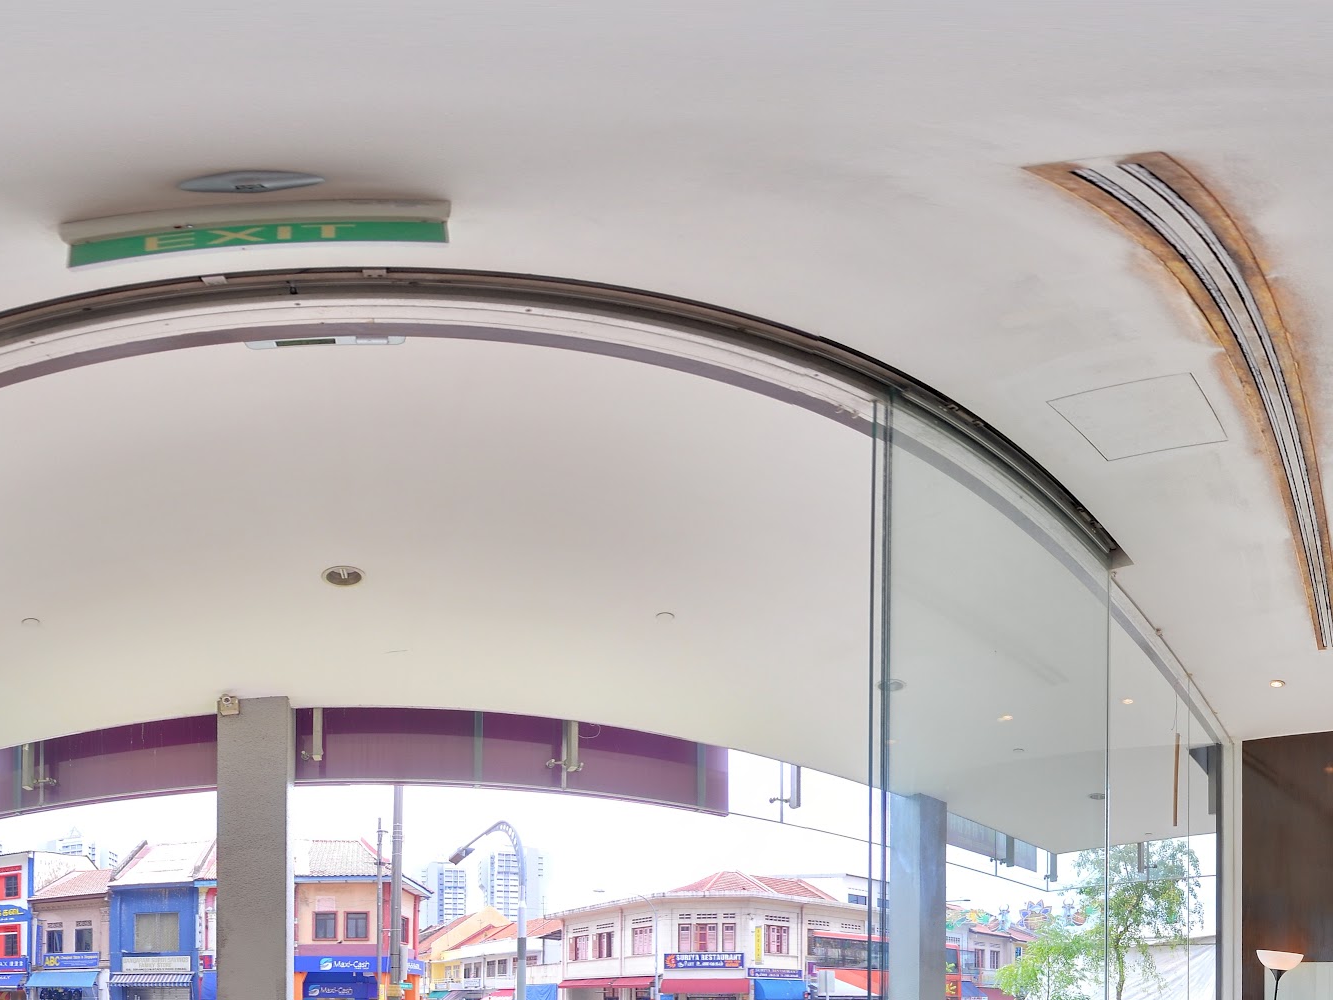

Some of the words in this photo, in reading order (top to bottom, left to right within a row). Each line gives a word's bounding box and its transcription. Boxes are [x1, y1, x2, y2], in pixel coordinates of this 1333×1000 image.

[144, 223, 356, 252] EXIT
[44, 955, 60, 967] ABC
[700, 953, 742, 961] RESTAURANT
[333, 960, 370, 968] Maxi-Cash
